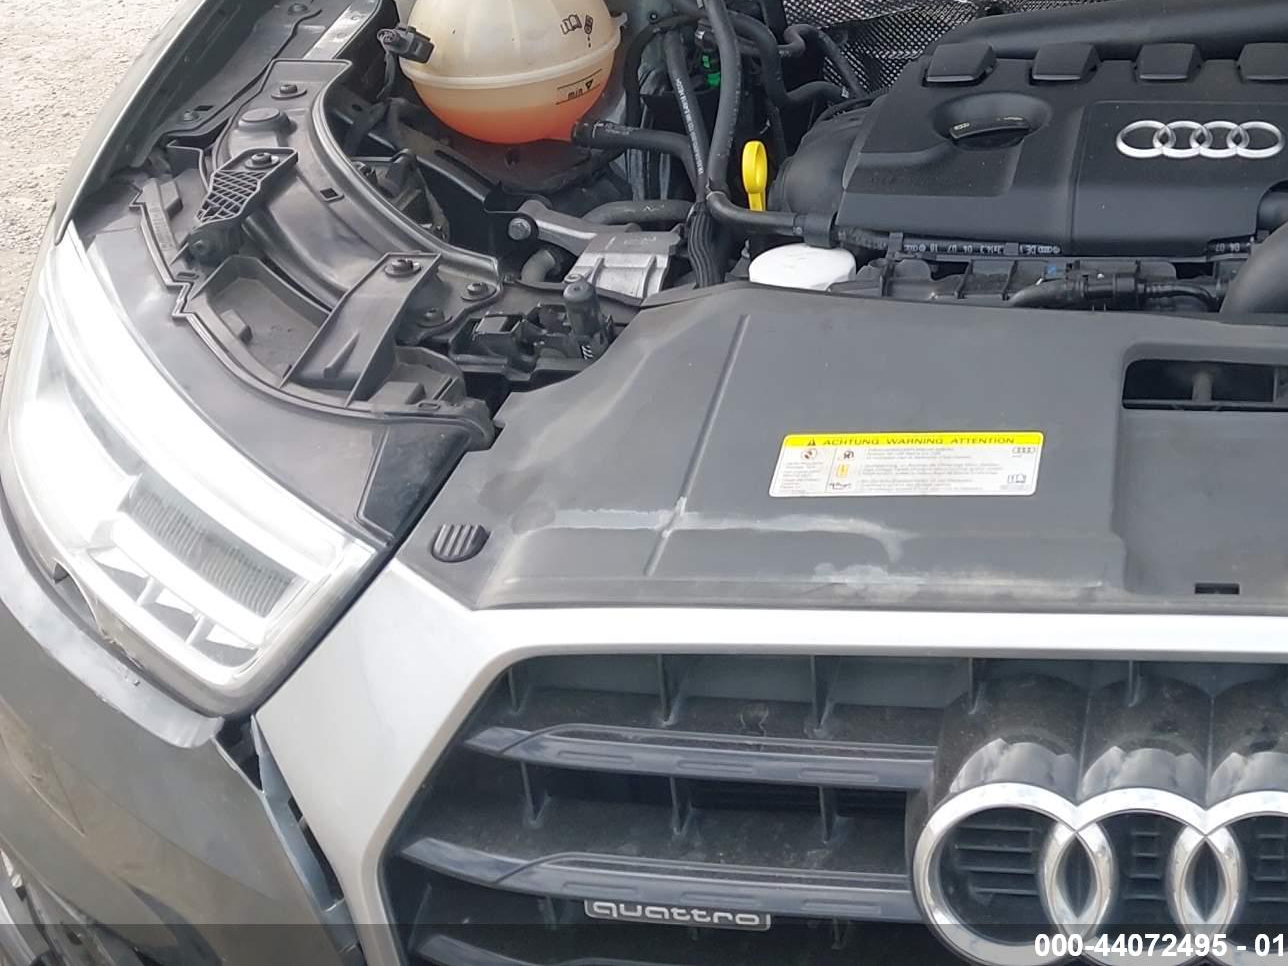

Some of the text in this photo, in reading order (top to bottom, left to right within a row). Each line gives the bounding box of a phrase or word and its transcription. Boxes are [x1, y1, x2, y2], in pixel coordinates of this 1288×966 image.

[823, 436, 1015, 446] ACHTUNG WARNING ATTENTION
[593, 901, 760, 925] quattro
